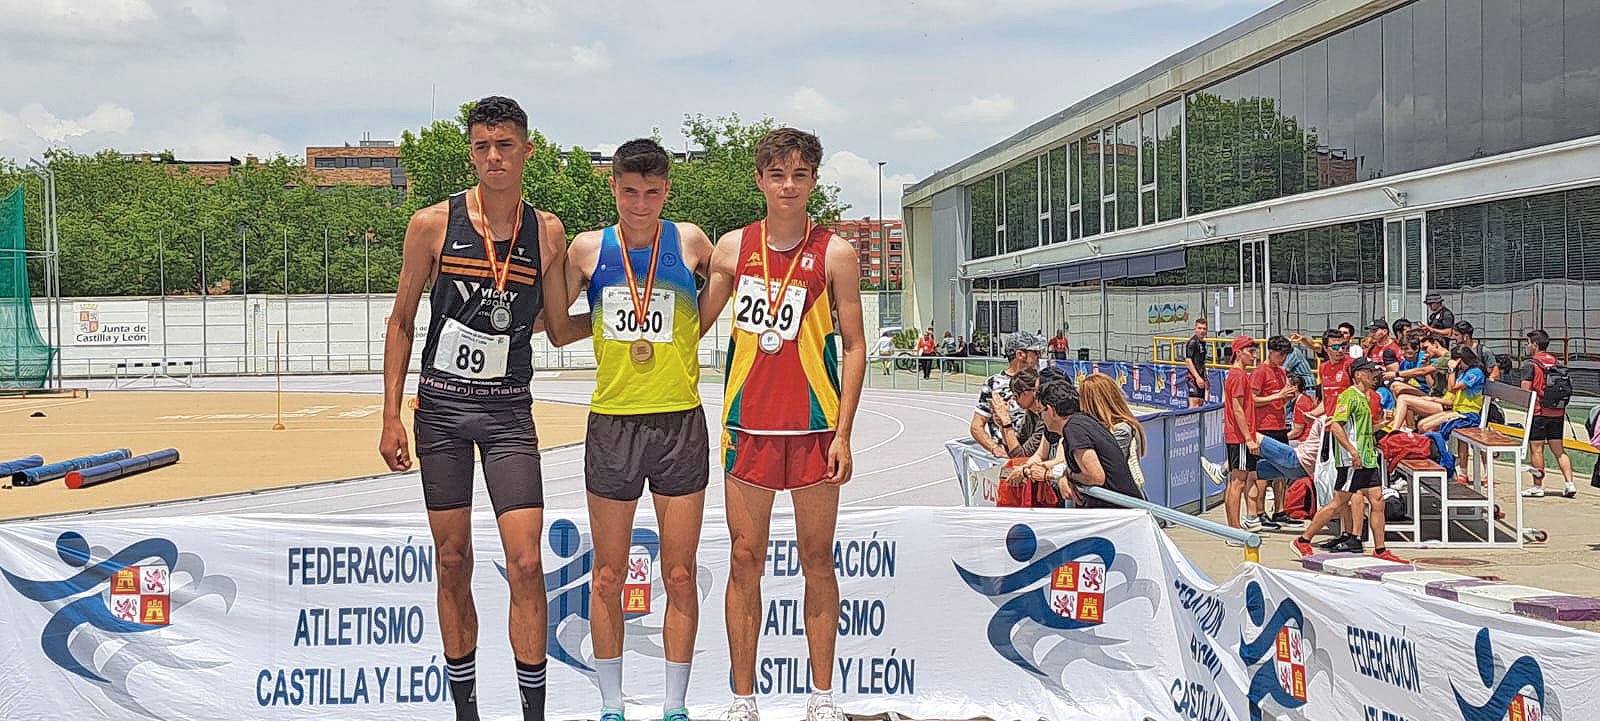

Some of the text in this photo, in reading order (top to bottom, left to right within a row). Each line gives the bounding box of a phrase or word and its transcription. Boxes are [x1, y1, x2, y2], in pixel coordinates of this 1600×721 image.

[481, 287, 518, 302] VICKY
[76, 333, 147, 343] Castilla y León
[102, 325, 146, 333] Junta de
[456, 344, 486, 374] 89
[491, 383, 529, 395] Kalen
[288, 536, 433, 585] FEDERACIÓN
[764, 532, 896, 577] FEDACIÓN
[294, 606, 424, 647] ATLETISMO
[765, 599, 885, 637] ATLSMO
[729, 657, 812, 695] STILL
[859, 648, 915, 695] LEÓN
[1347, 625, 1421, 694] FEDERACIÓN
[256, 667, 369, 706] CASTILLA
[373, 667, 392, 704] Y
